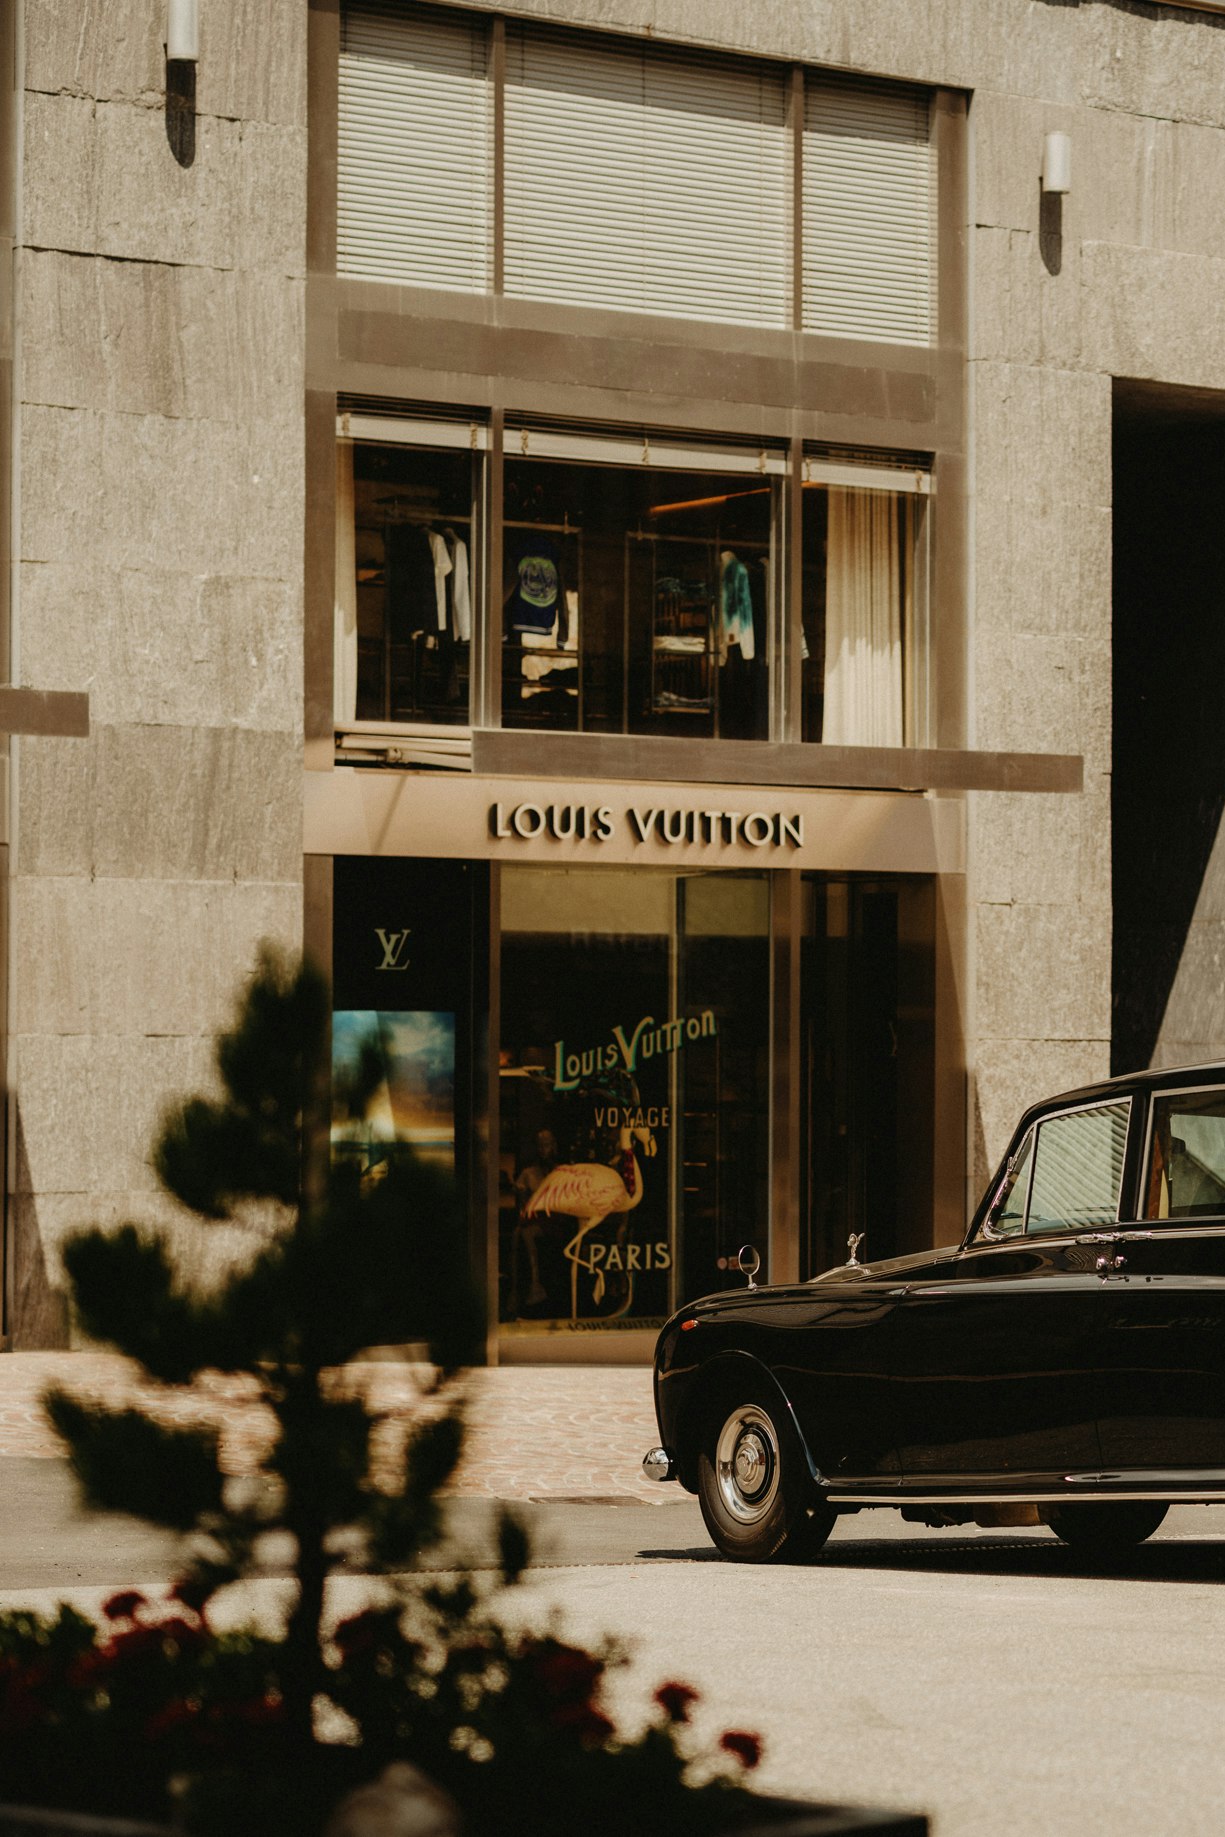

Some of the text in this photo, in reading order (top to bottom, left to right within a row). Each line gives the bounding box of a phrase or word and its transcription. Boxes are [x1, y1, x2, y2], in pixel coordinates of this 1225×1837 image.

[490, 802, 804, 848] LOUIS VUITTON
[594, 1106, 670, 1129] VOYAGE
[588, 1242, 672, 1275] PARIS
